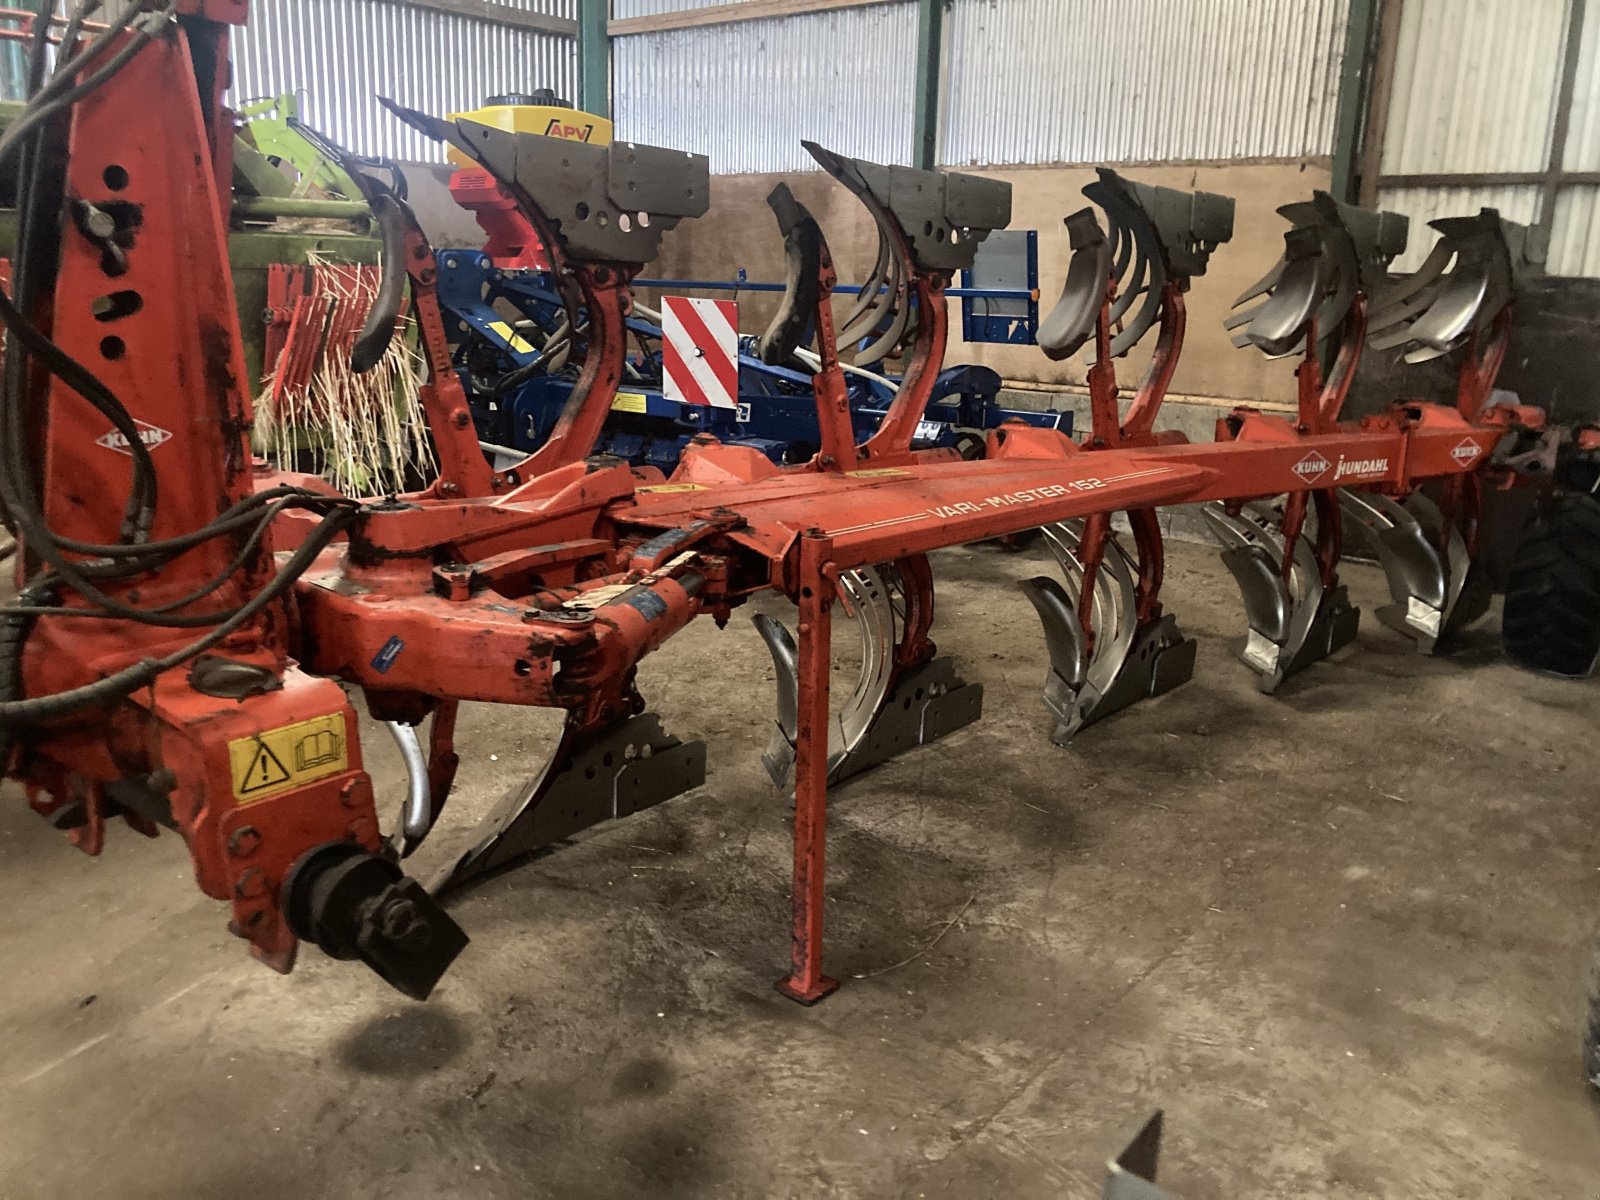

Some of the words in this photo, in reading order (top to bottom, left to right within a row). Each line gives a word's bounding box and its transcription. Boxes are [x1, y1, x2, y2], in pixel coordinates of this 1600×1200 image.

[549, 123, 588, 141] APV
[1296, 460, 1327, 474] KUHN
[926, 484, 1071, 519] VARI-MASTER
[1068, 477, 1107, 491] 152
